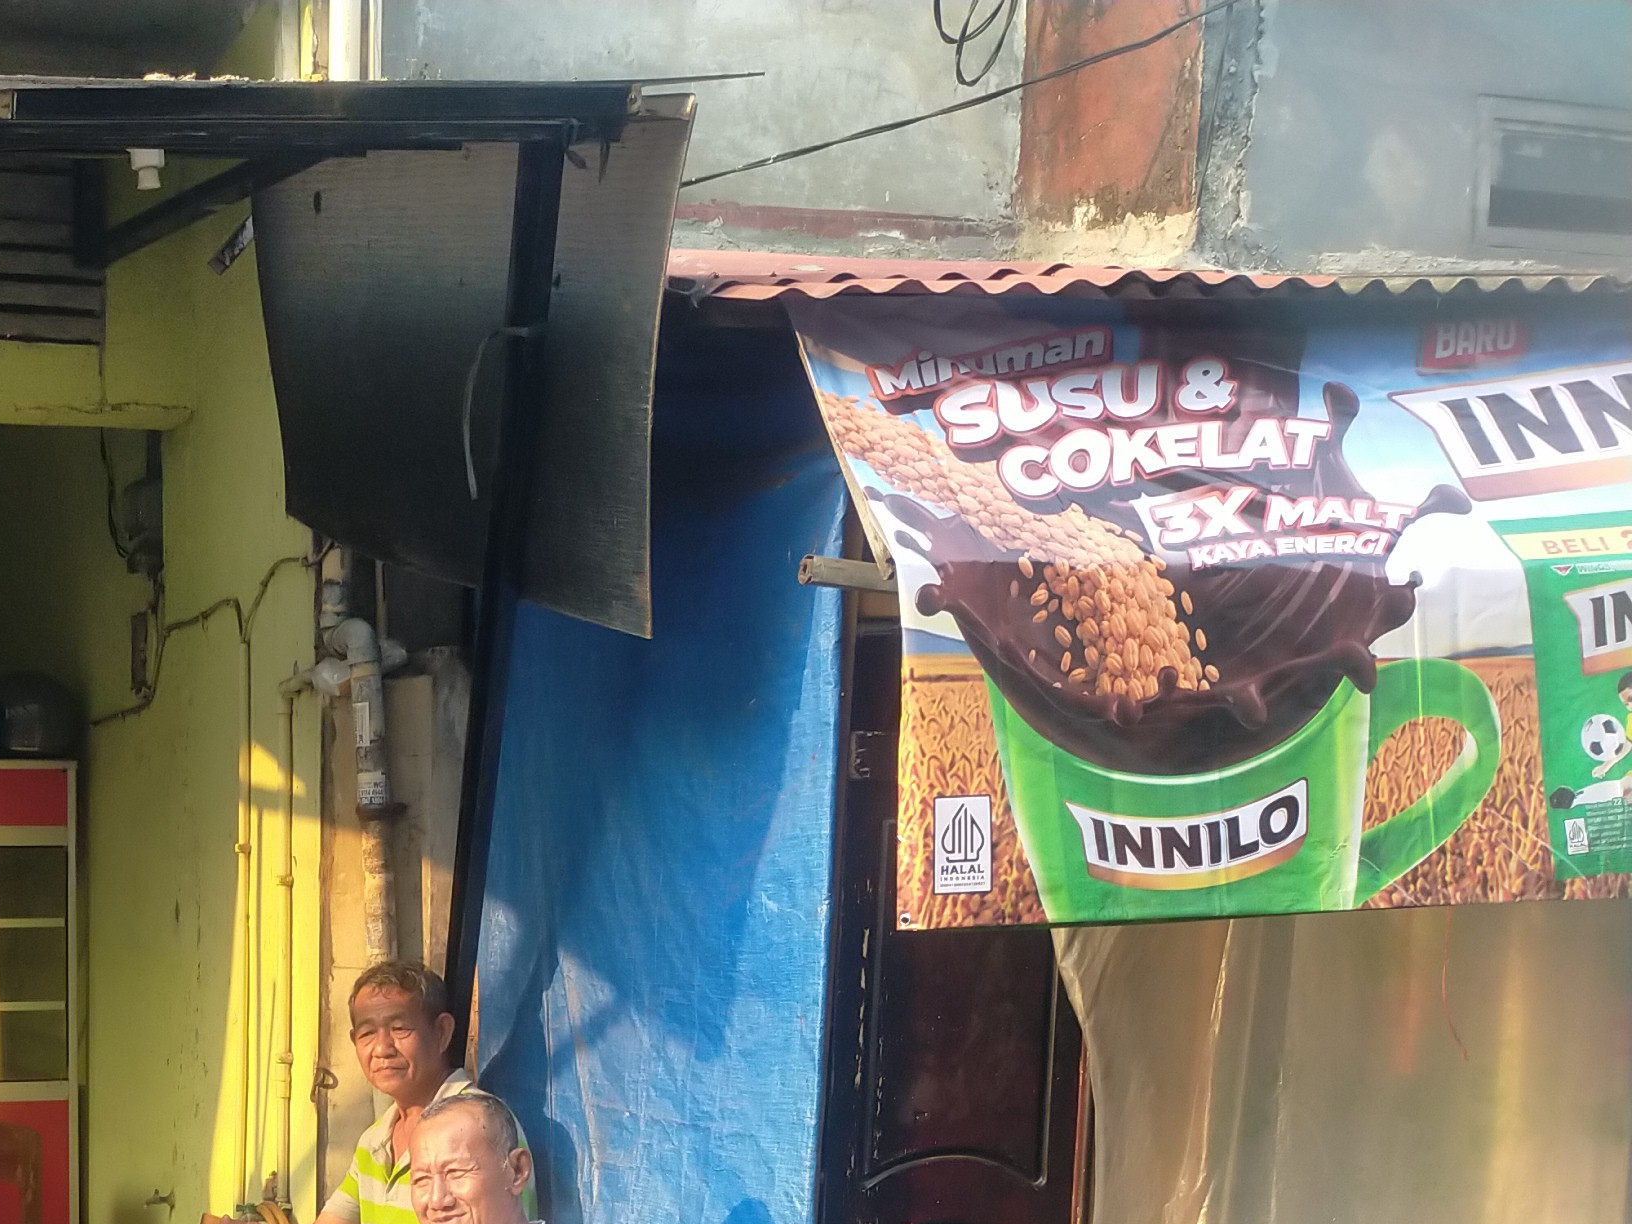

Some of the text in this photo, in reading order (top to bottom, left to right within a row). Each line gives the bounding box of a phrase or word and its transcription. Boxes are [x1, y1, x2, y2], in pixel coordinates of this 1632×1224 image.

[871, 330, 1106, 396] Minuman
[1435, 319, 1516, 359] BARU
[939, 358, 1236, 445] SUSU &
[1000, 420, 1331, 497] COKELAT
[1154, 486, 1414, 544] 3X MALT
[1191, 531, 1391, 569] KAYA ENERGI
[1541, 536, 1610, 555] BELI
[1089, 794, 1300, 869] INNILO
[940, 863, 985, 875] HALAL
